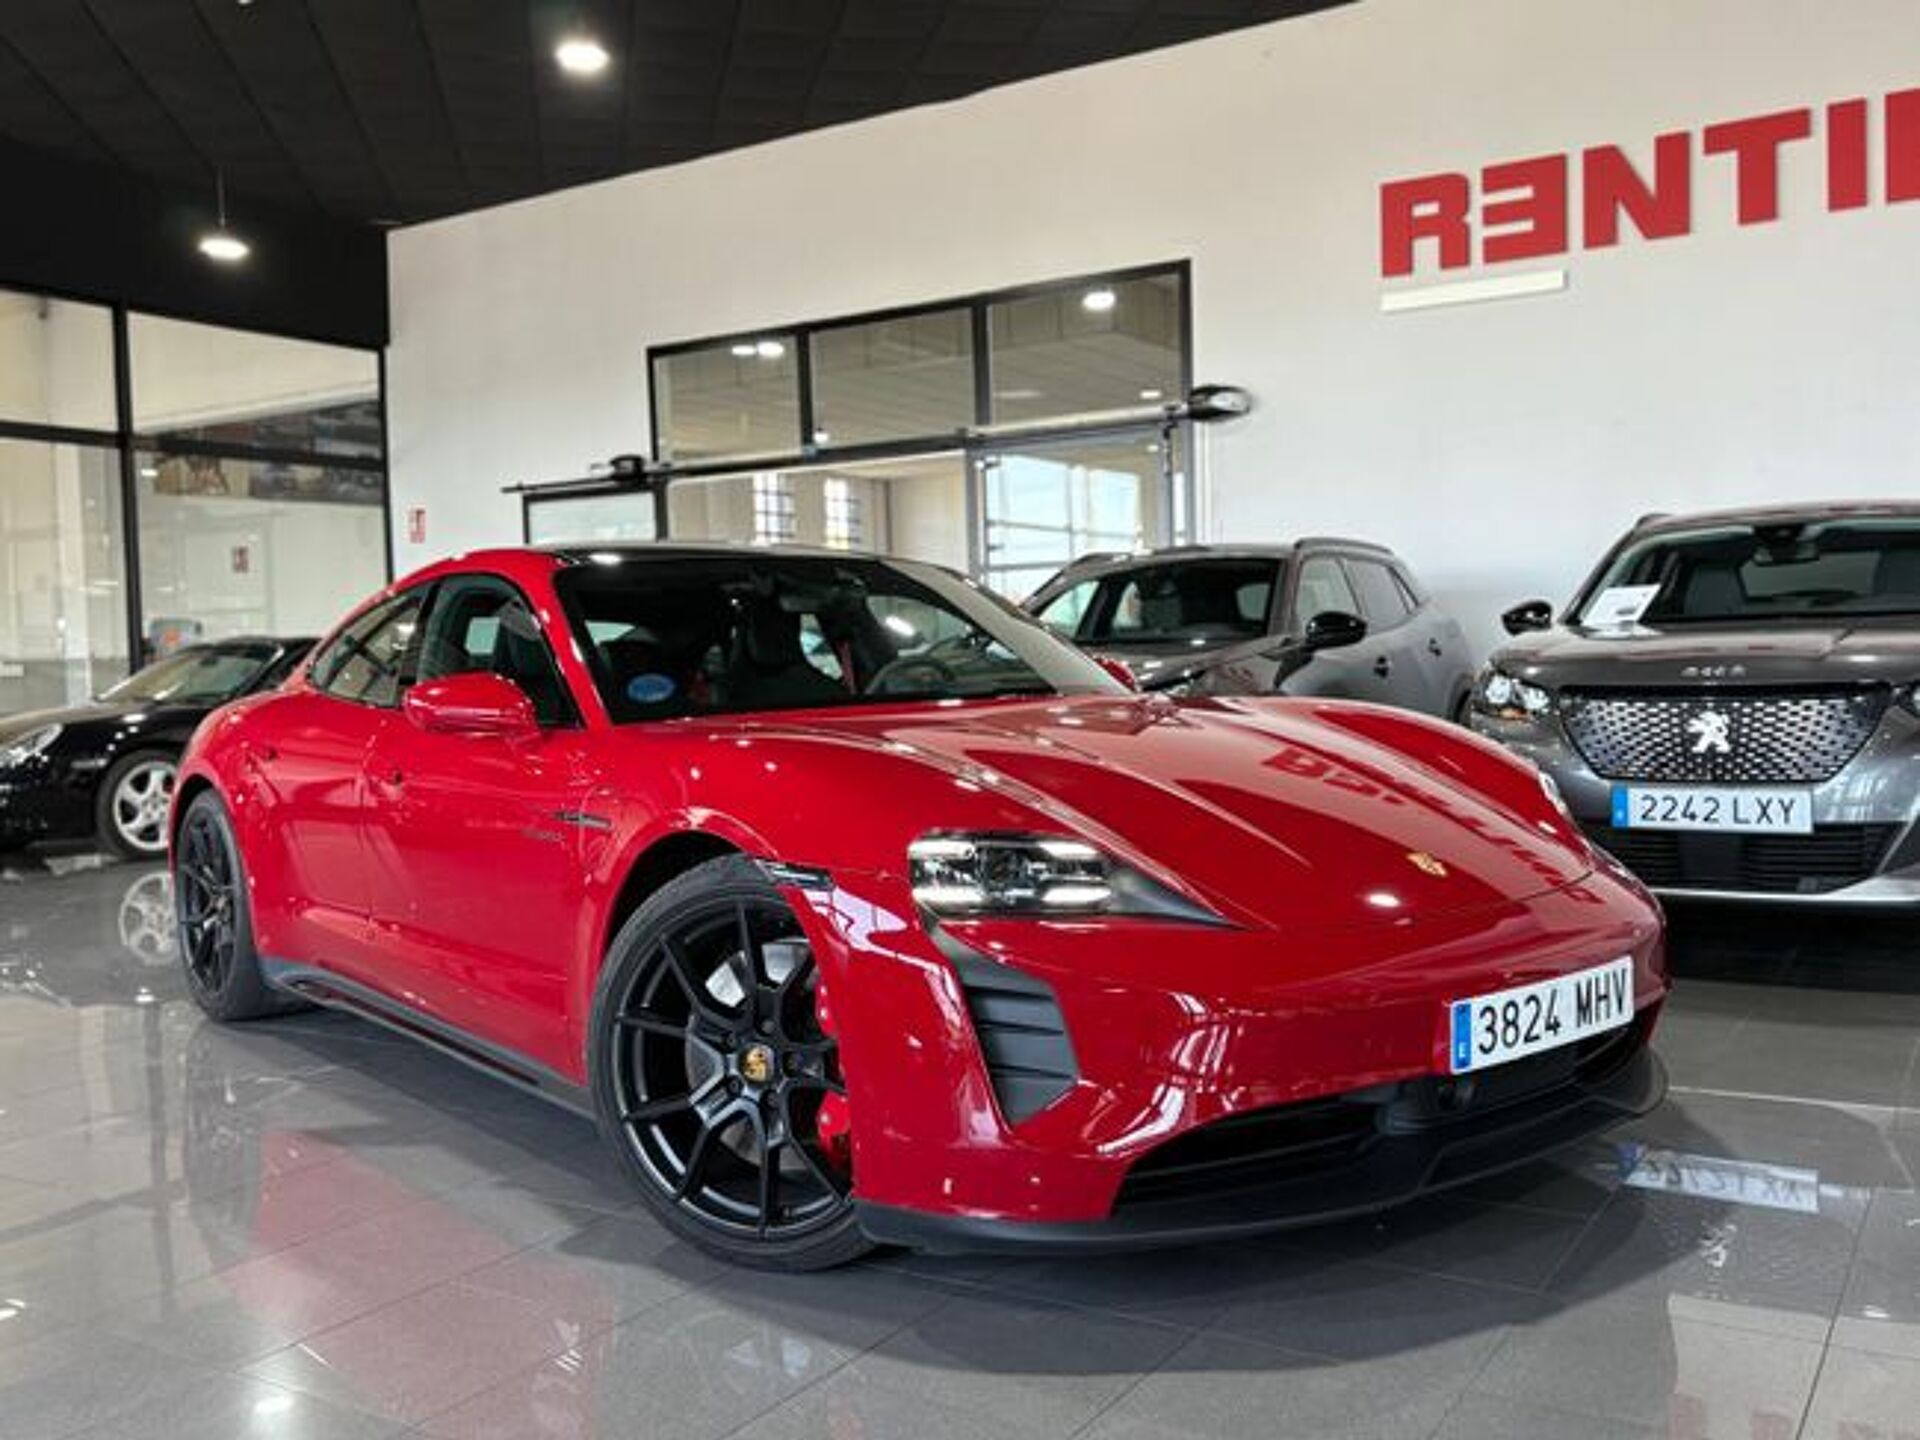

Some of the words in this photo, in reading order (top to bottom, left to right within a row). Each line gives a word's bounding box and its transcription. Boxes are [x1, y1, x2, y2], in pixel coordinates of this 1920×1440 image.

[1640, 794, 1720, 822] 2242
[1732, 797, 1796, 824] LXY
[1478, 988, 1561, 1055] 3824
[1576, 968, 1628, 1028] MHV
